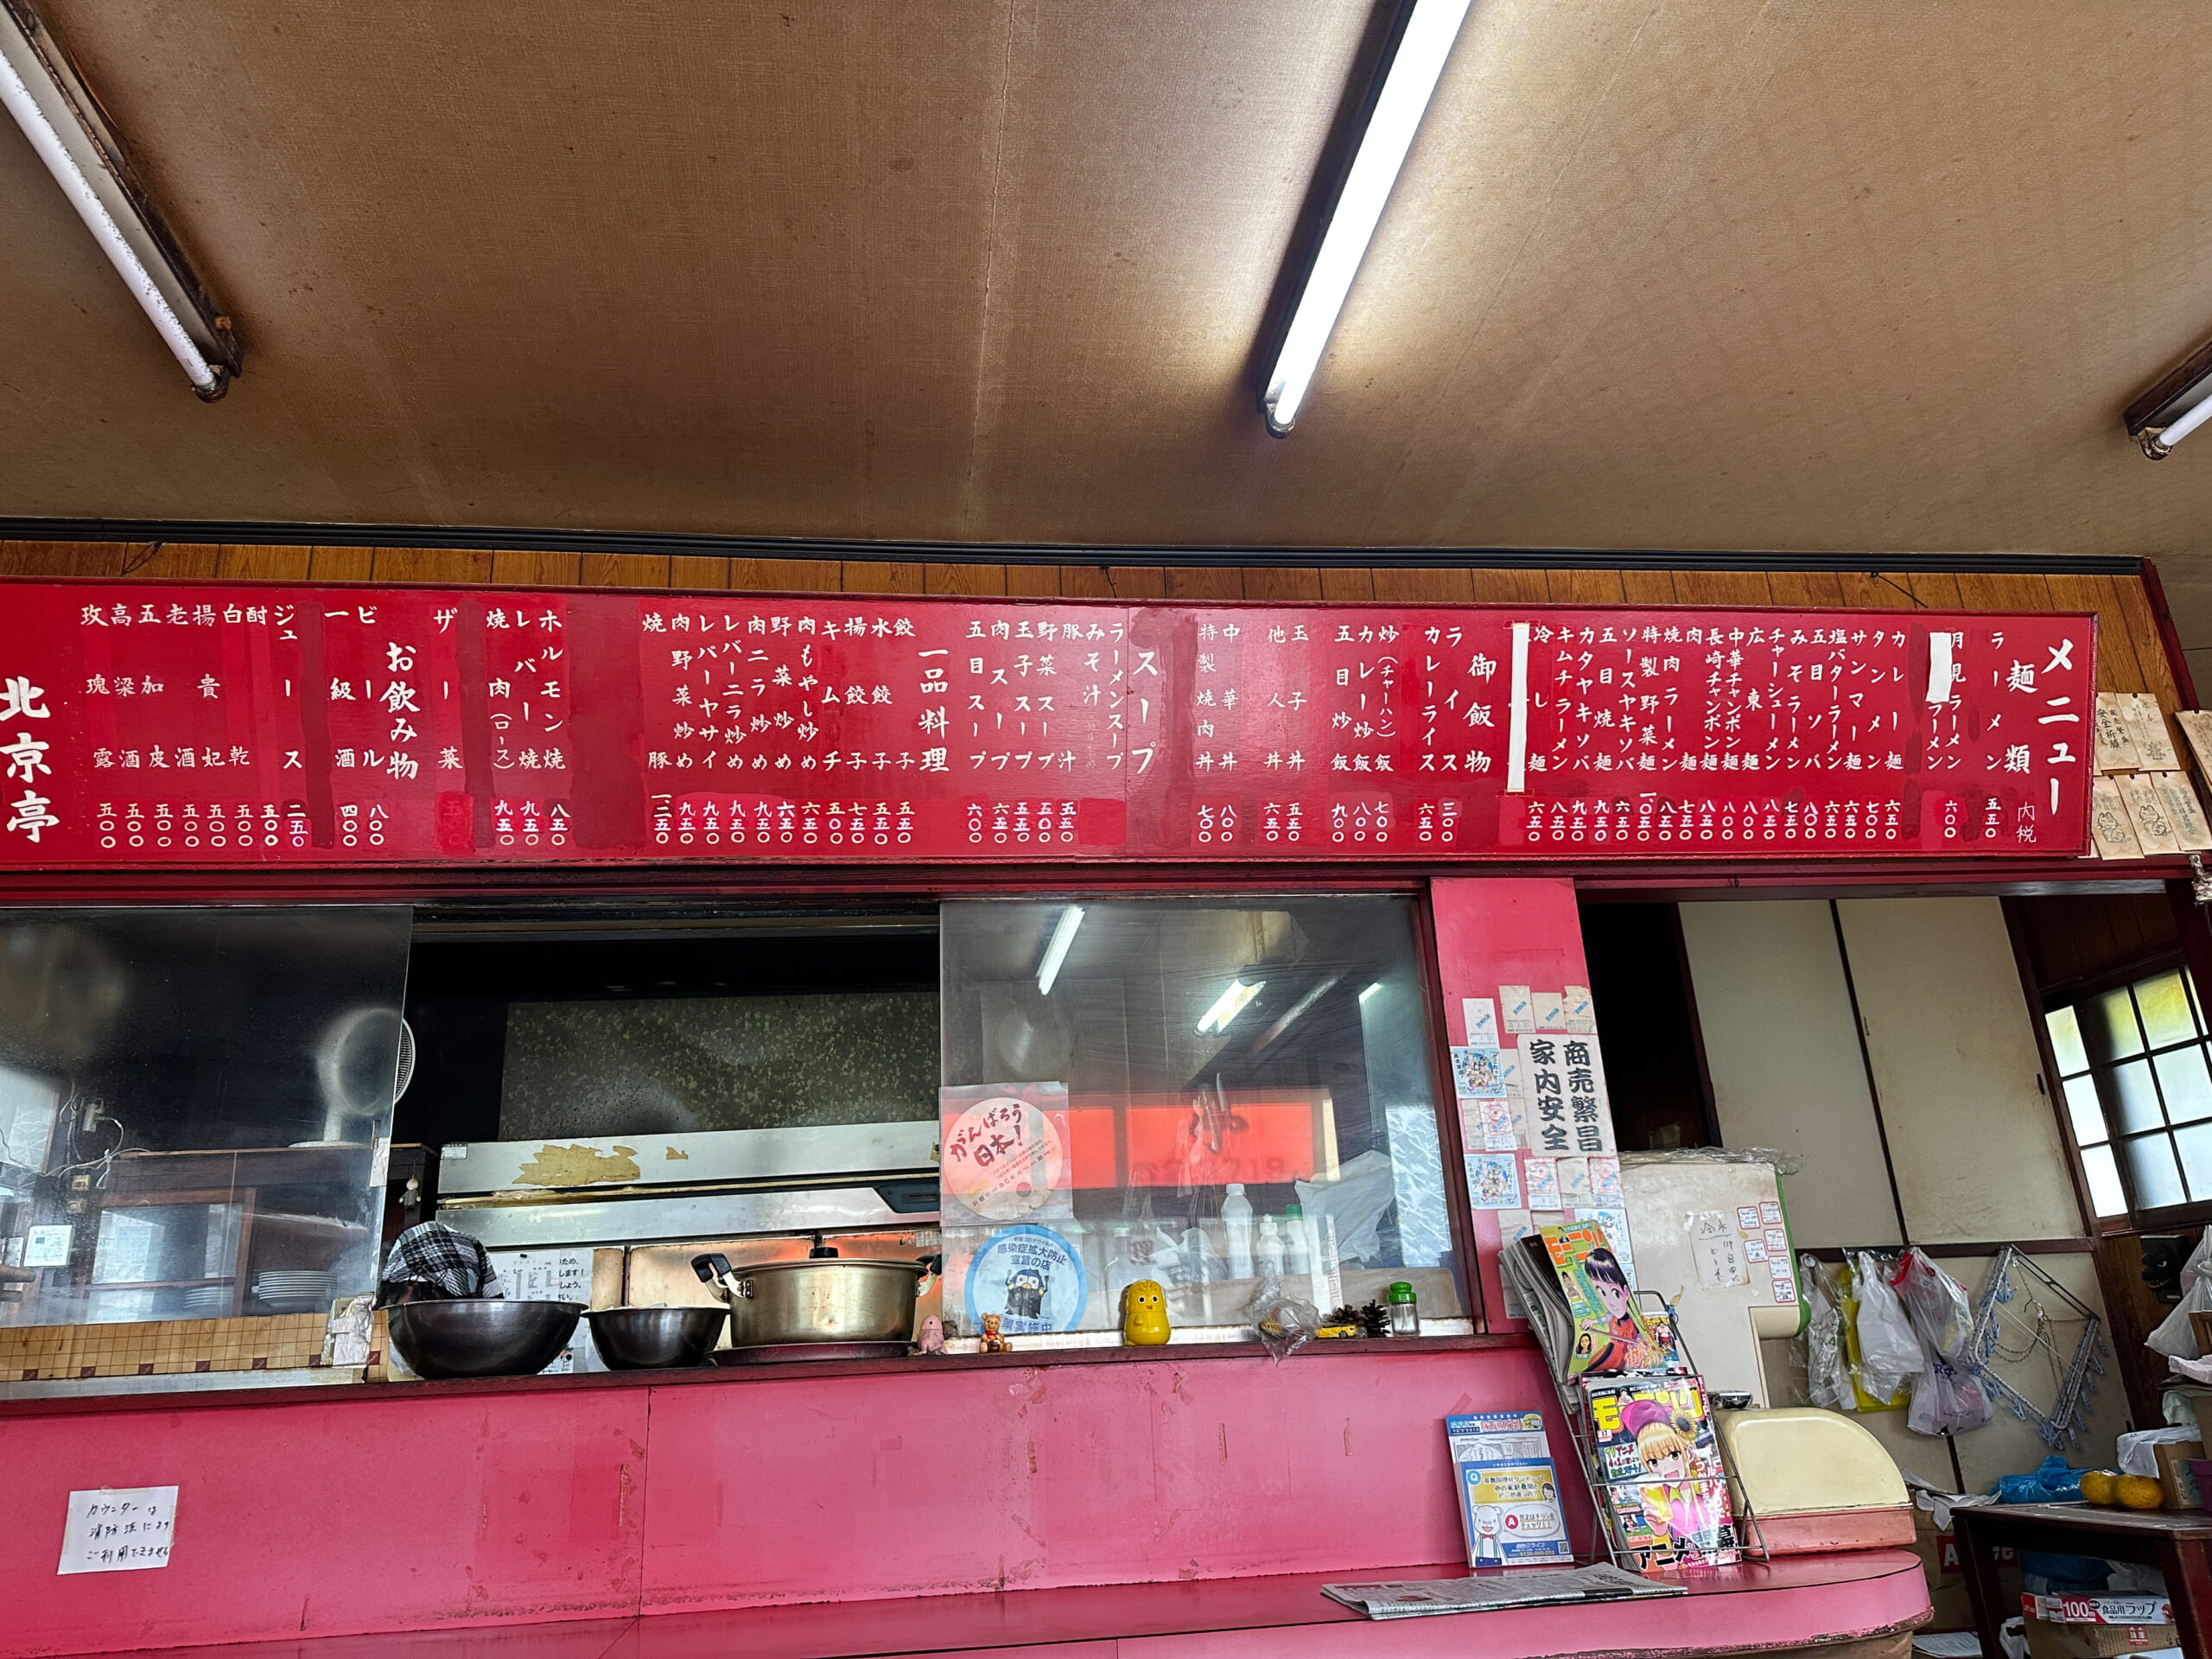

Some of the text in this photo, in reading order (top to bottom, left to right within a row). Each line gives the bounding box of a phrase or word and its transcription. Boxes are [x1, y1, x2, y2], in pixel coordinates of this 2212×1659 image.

[80, 604, 116, 768] 玫瑰露
[138, 604, 170, 768] 五加皮
[166, 603, 195, 768] 老酒
[273, 605, 302, 769] ジュース
[324, 611, 356, 768] 一級酒
[358, 606, 385, 767] ビール
[379, 642, 421, 779] お飲み物
[434, 607, 463, 770] ザー菜
[514, 610, 542, 769] レバー焼
[538, 609, 566, 769] ホルモン焼
[642, 612, 672, 769] 焼豚
[671, 613, 695, 768] 肉野菜炒め
[697, 614, 719, 769] レバーヤサイ
[722, 614, 747, 769] レバーニラ炒め
[747, 615, 772, 770] 肉ニラ炒め
[771, 616, 794, 770] 野菜炒め
[798, 616, 819, 770] 肉もやし炒め
[821, 620, 842, 772] キムチ
[843, 616, 869, 770] 揚餃子
[871, 617, 893, 771] 水餃子
[893, 617, 916, 770] 餃子
[918, 649, 950, 772] 一品料理
[966, 620, 987, 769] 五目スープ
[990, 619, 1011, 771] 肉スープ
[1014, 620, 1033, 769] 玉子スープ
[1036, 620, 1058, 769] 野菜スープ
[1057, 622, 1083, 772] 豚汁
[1083, 623, 1105, 707] みそ汁
[1106, 622, 1126, 771] ラーメンスープ
[1131, 651, 1159, 774] スープ
[1195, 623, 1218, 772] 特製焼肉丼
[1218, 622, 1240, 772] 中華丼
[1286, 624, 1310, 772] 玉子丼
[1330, 625, 1355, 771] 五目炒飯
[1352, 626, 1375, 772] カレー炒飯
[1419, 626, 1441, 771] カレーライス
[1440, 626, 1462, 771] ライス
[1463, 652, 1497, 773] 御飯物
[1528, 625, 1554, 772] 冷し麺
[1552, 626, 1574, 770] キムチラーメン
[1573, 626, 1595, 770] カタヤキソバ
[1592, 626, 1618, 771] 五目焼麺
[1617, 627, 1637, 770] ソースヤキソバ
[1637, 626, 1661, 771] 特製野菜麺
[1662, 626, 1683, 771] 焼肉ラーメン
[1679, 626, 1703, 771] 肉麺
[1700, 627, 1725, 771] 長崎チャンポン麺
[1720, 626, 1745, 771] 中華チャンポン麺
[1741, 626, 1764, 771] 広東麺
[1764, 627, 1785, 770] チャーシューメン
[1786, 629, 1808, 769] みそラーメン
[1804, 628, 1827, 768] 五目ソバ
[1827, 628, 1848, 770] 塩バターラーメン
[1843, 629, 1867, 770] サンマー麺
[1866, 630, 1885, 769] タンメン
[1885, 631, 1906, 770] カレー麺
[1945, 632, 1966, 769] 月見ラーメン
[1986, 632, 2005, 770] ラーメン
[2004, 659, 2037, 774] 麺類
[2037, 639, 2080, 815] メニュー
[0, 676, 60, 843] 北京亭
[2015, 802, 2037, 842] 内税
[950, 1103, 1022, 1162] がんばろう
[1529, 1039, 1569, 1152] 家内安全
[1563, 1039, 1603, 1153] 商売繁昌
[997, 1243, 1068, 1266] 感染症拡大防止
[1010, 1255, 1052, 1271] 宣言の店
[1471, 1473, 1478, 1482] Q
[2101, 1600, 2158, 1616] 食品用ラップ
